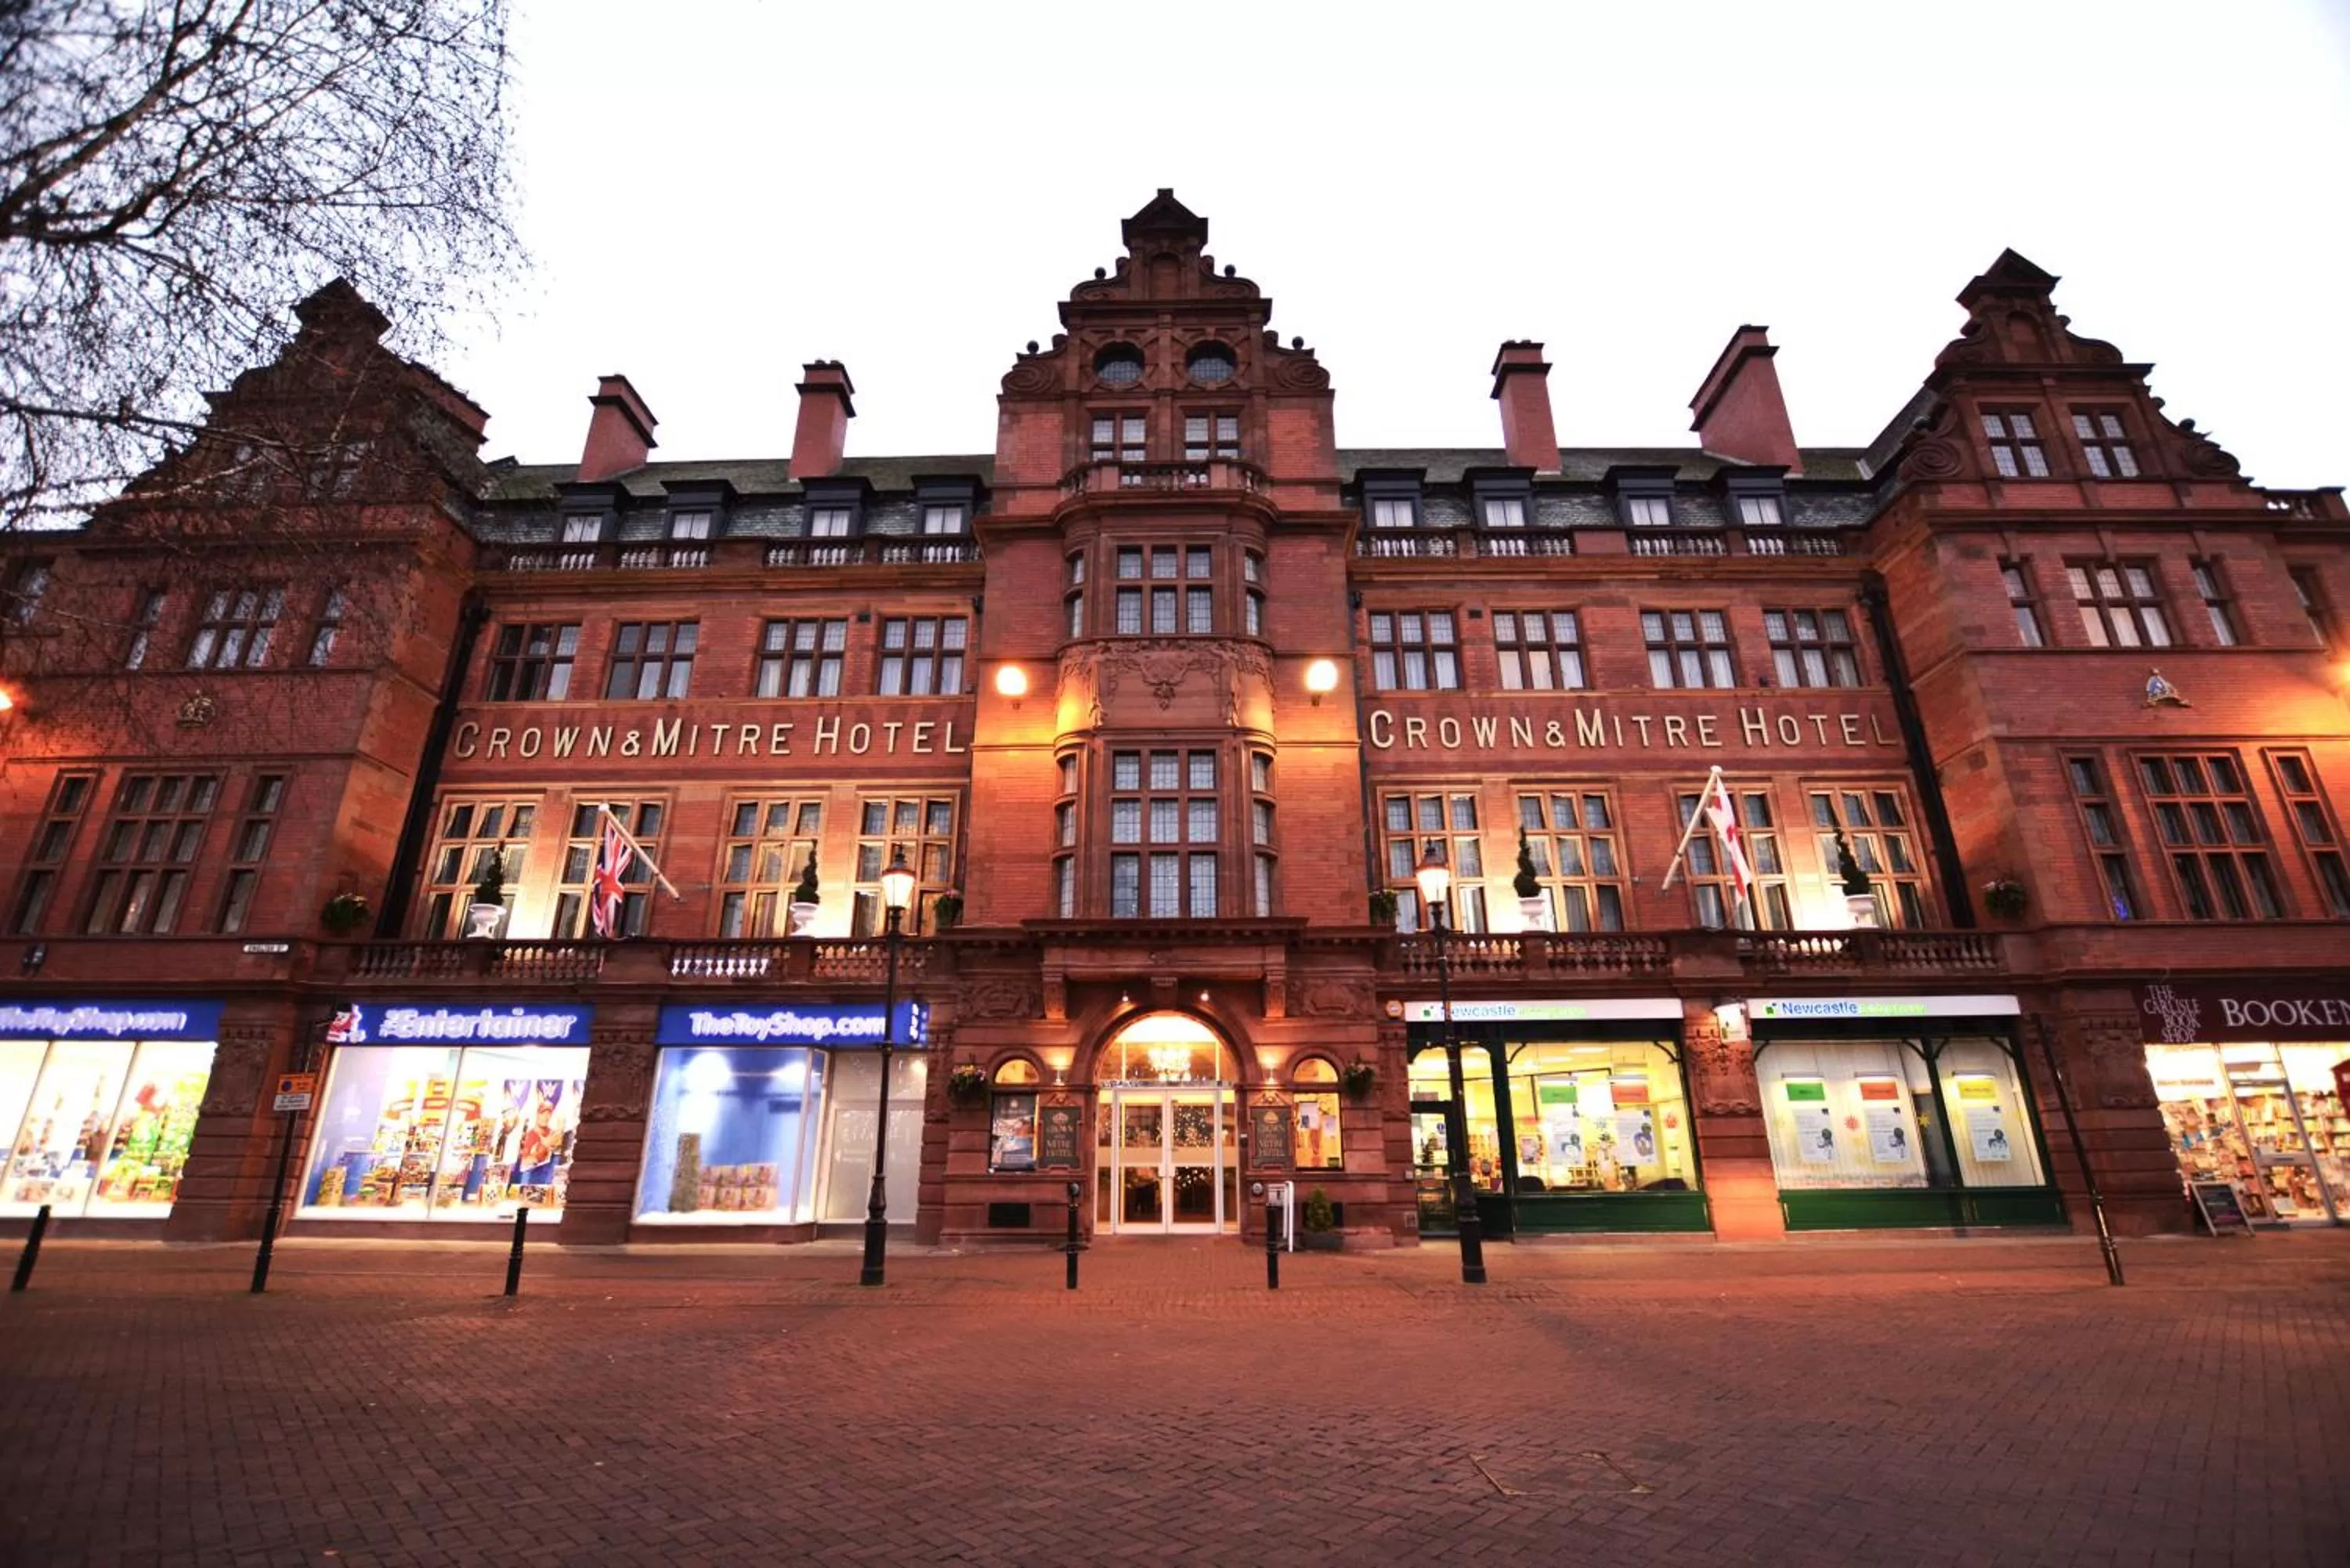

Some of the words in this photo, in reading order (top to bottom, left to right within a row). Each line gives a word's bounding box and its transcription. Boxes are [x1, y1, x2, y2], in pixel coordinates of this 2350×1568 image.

[1740, 706, 1900, 746] HOTEL
[814, 716, 966, 755] HOTEL
[2146, 985, 2176, 999] THE
[1781, 1001, 1858, 1015] Newcastle
[2143, 998, 2202, 1015] CARLISLE
[2164, 1013, 2202, 1028] BOOK
[2161, 1027, 2196, 1043] SHOP
